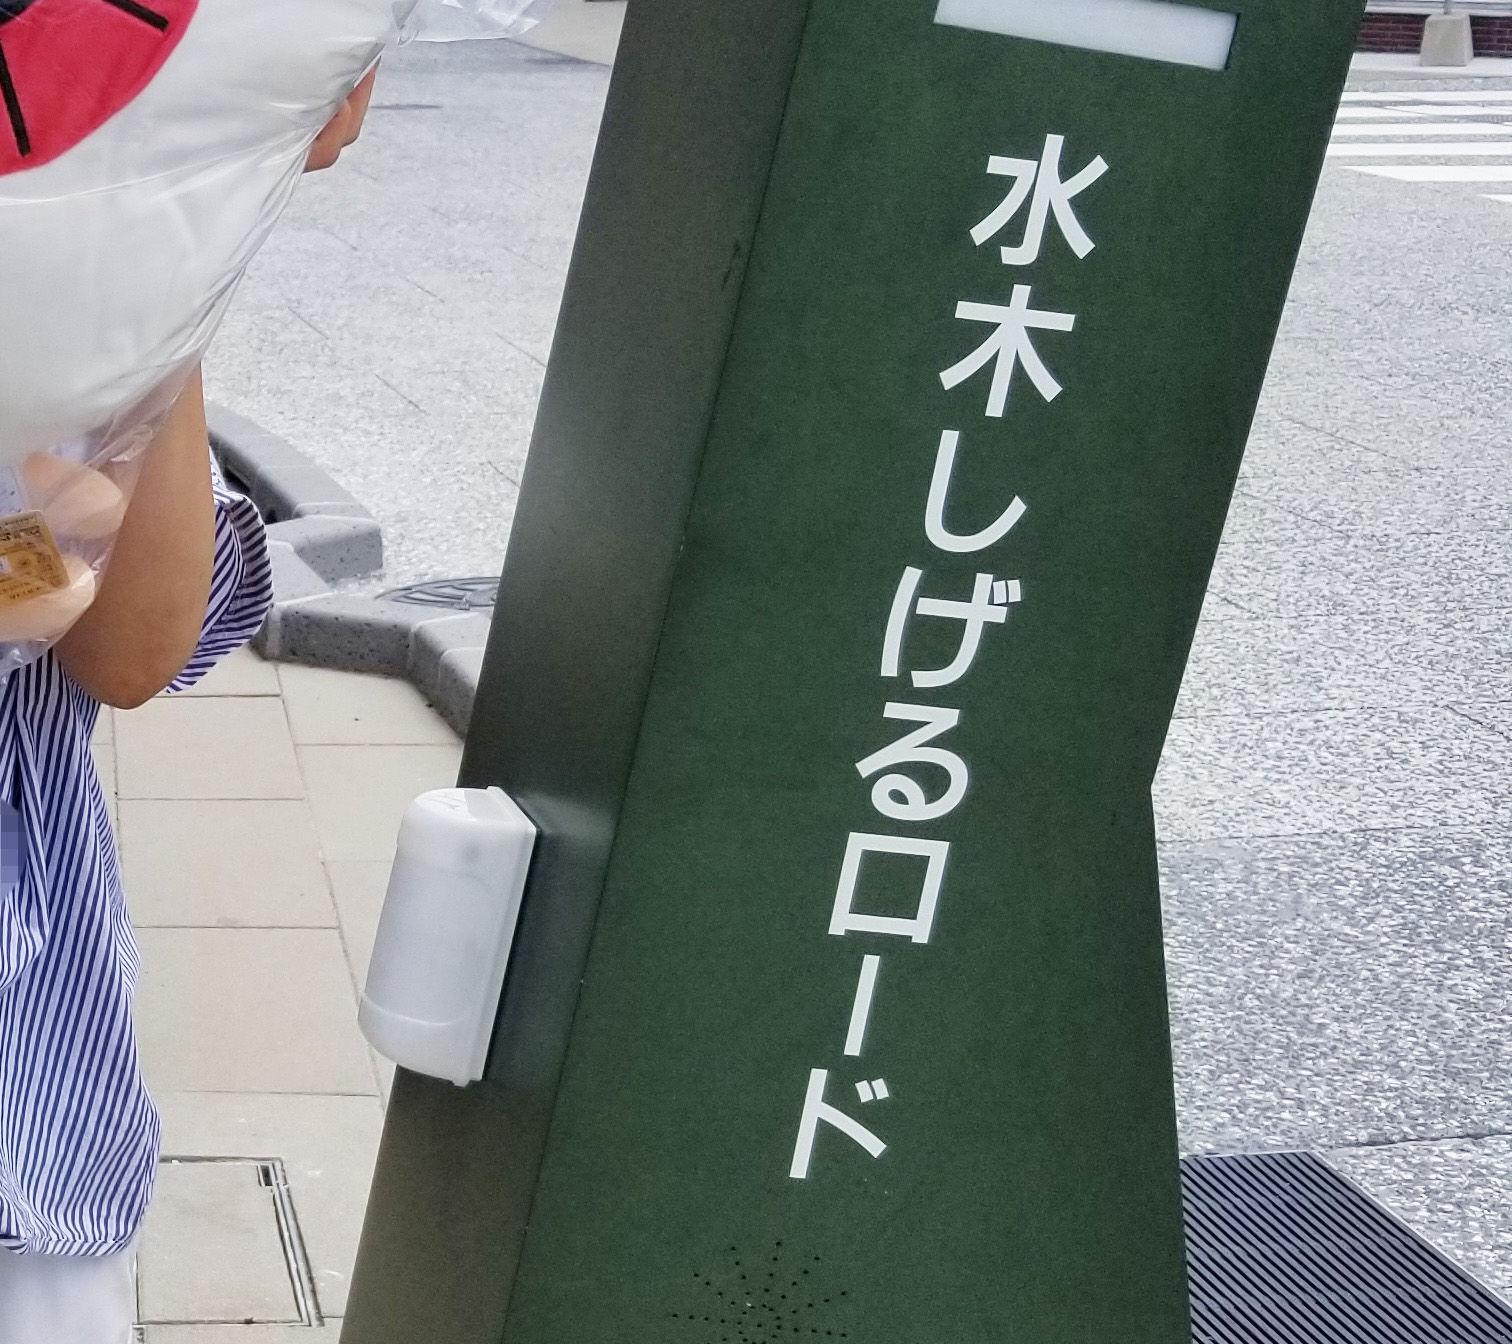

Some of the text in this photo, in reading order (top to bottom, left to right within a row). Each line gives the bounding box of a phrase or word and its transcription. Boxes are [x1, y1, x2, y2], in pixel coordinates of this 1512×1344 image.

[788, 133, 1110, 1179] 水木しげるロード
